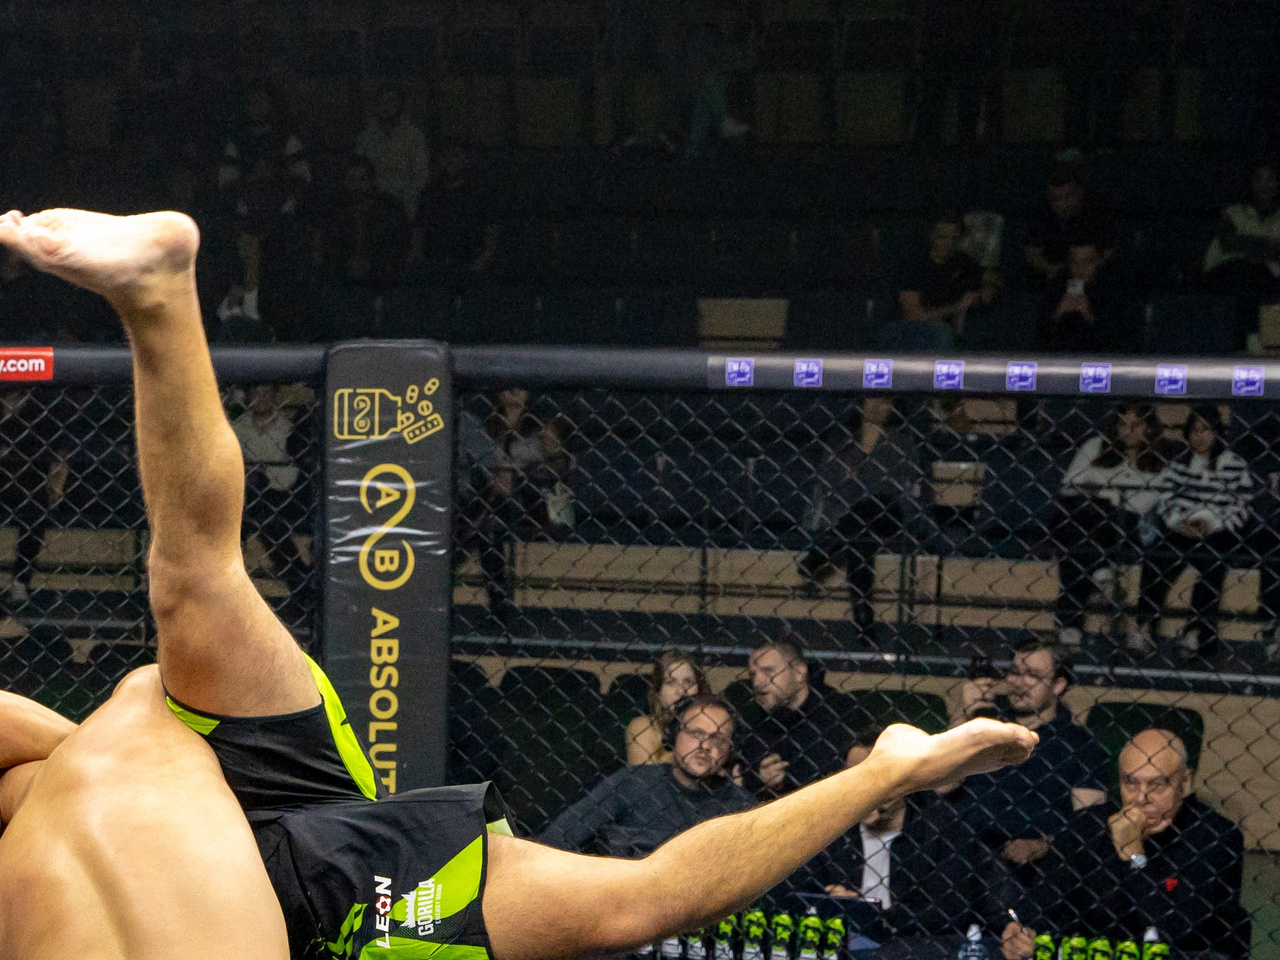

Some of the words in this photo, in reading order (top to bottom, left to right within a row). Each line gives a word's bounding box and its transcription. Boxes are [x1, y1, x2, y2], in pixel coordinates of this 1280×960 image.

[368, 608, 400, 797] ABSOLUT
[373, 875, 393, 949] LEON
[417, 878, 436, 937] GORILLA
